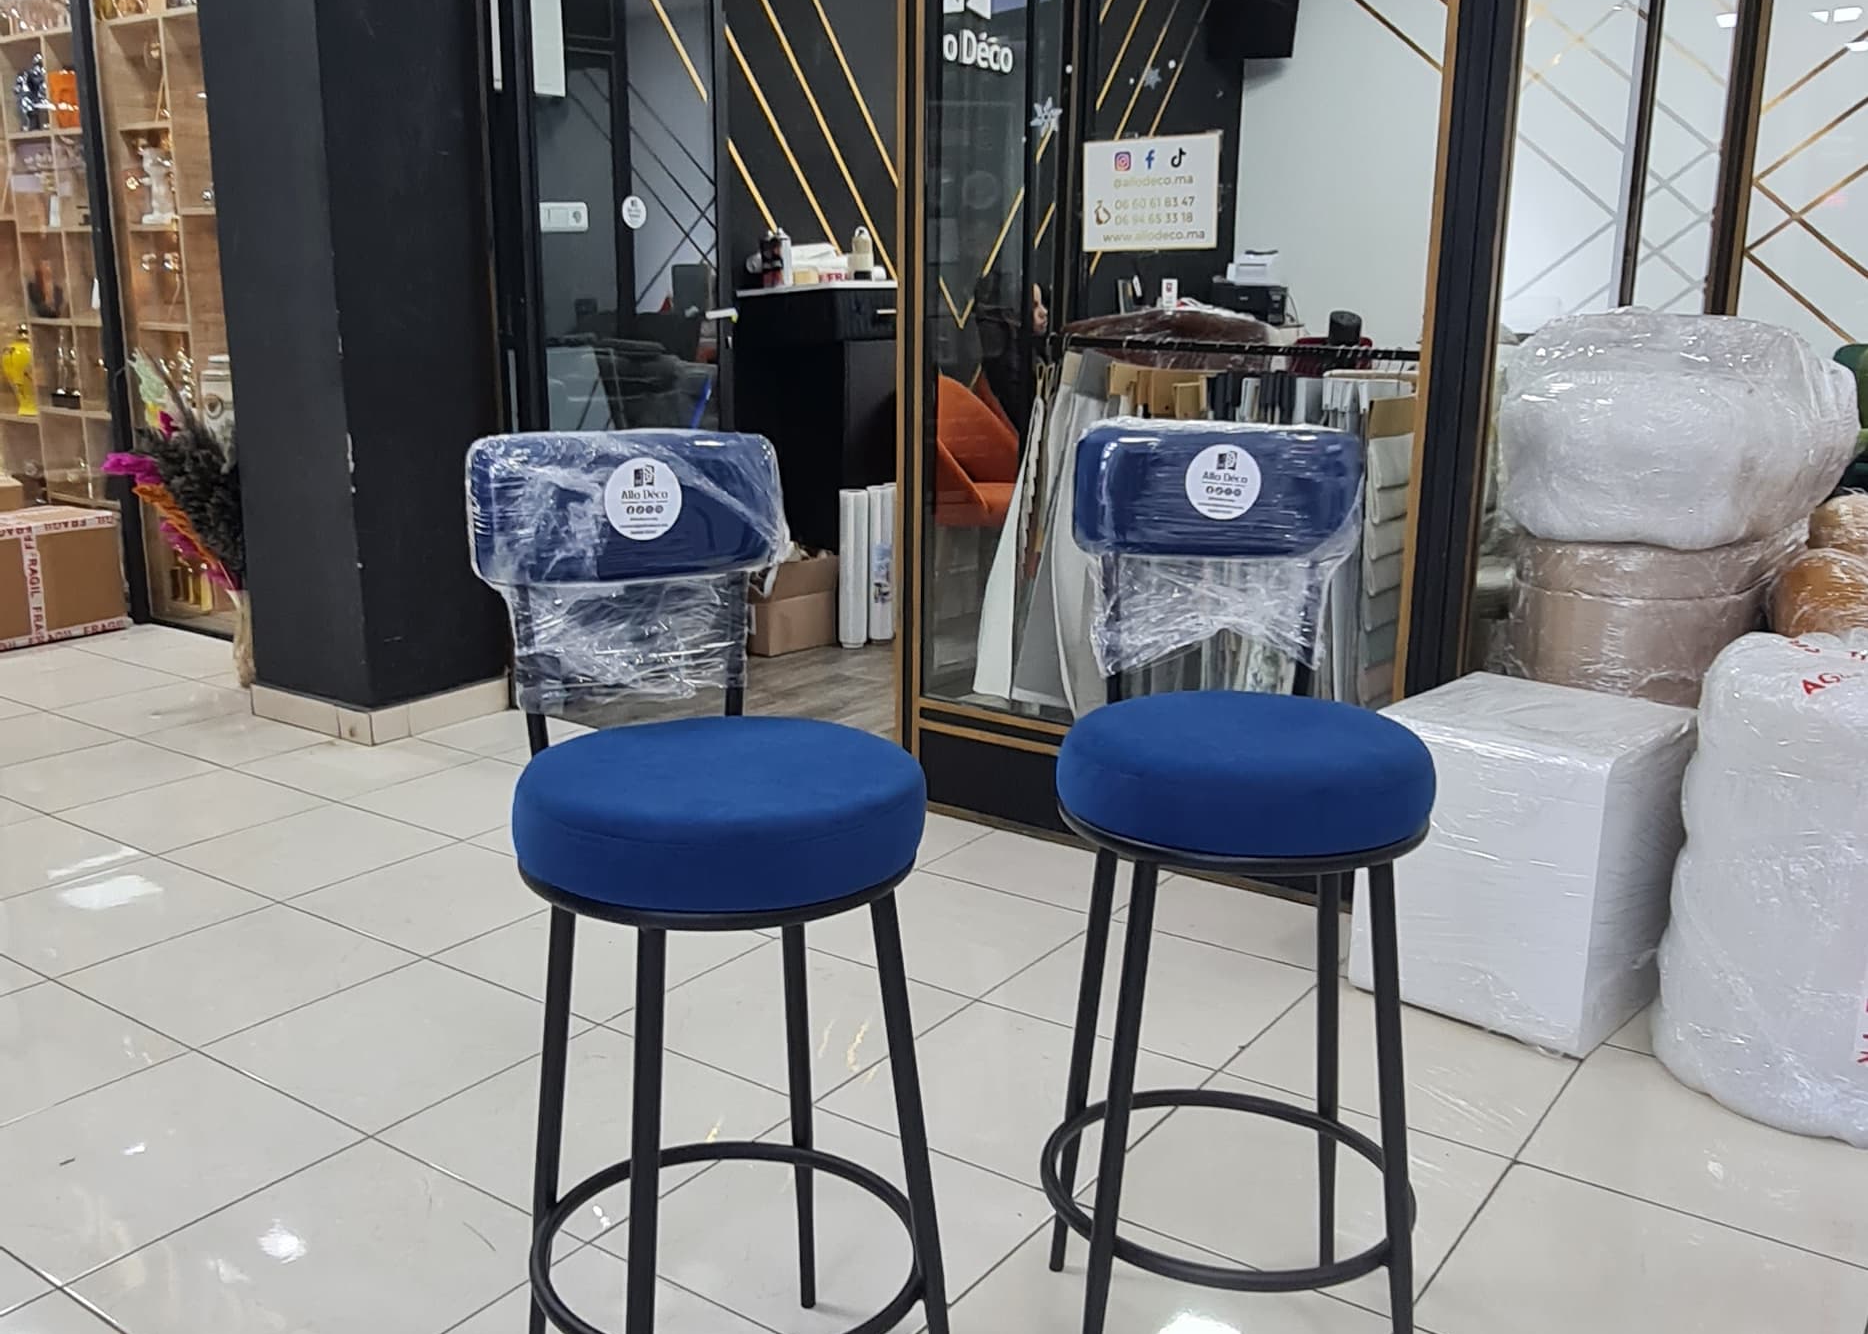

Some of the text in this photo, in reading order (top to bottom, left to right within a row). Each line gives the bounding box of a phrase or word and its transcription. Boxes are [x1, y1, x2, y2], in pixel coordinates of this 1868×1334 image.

[959, 29, 1013, 74] Déco
[1181, 195, 1195, 207] 47
[1165, 212, 1178, 223] 33
